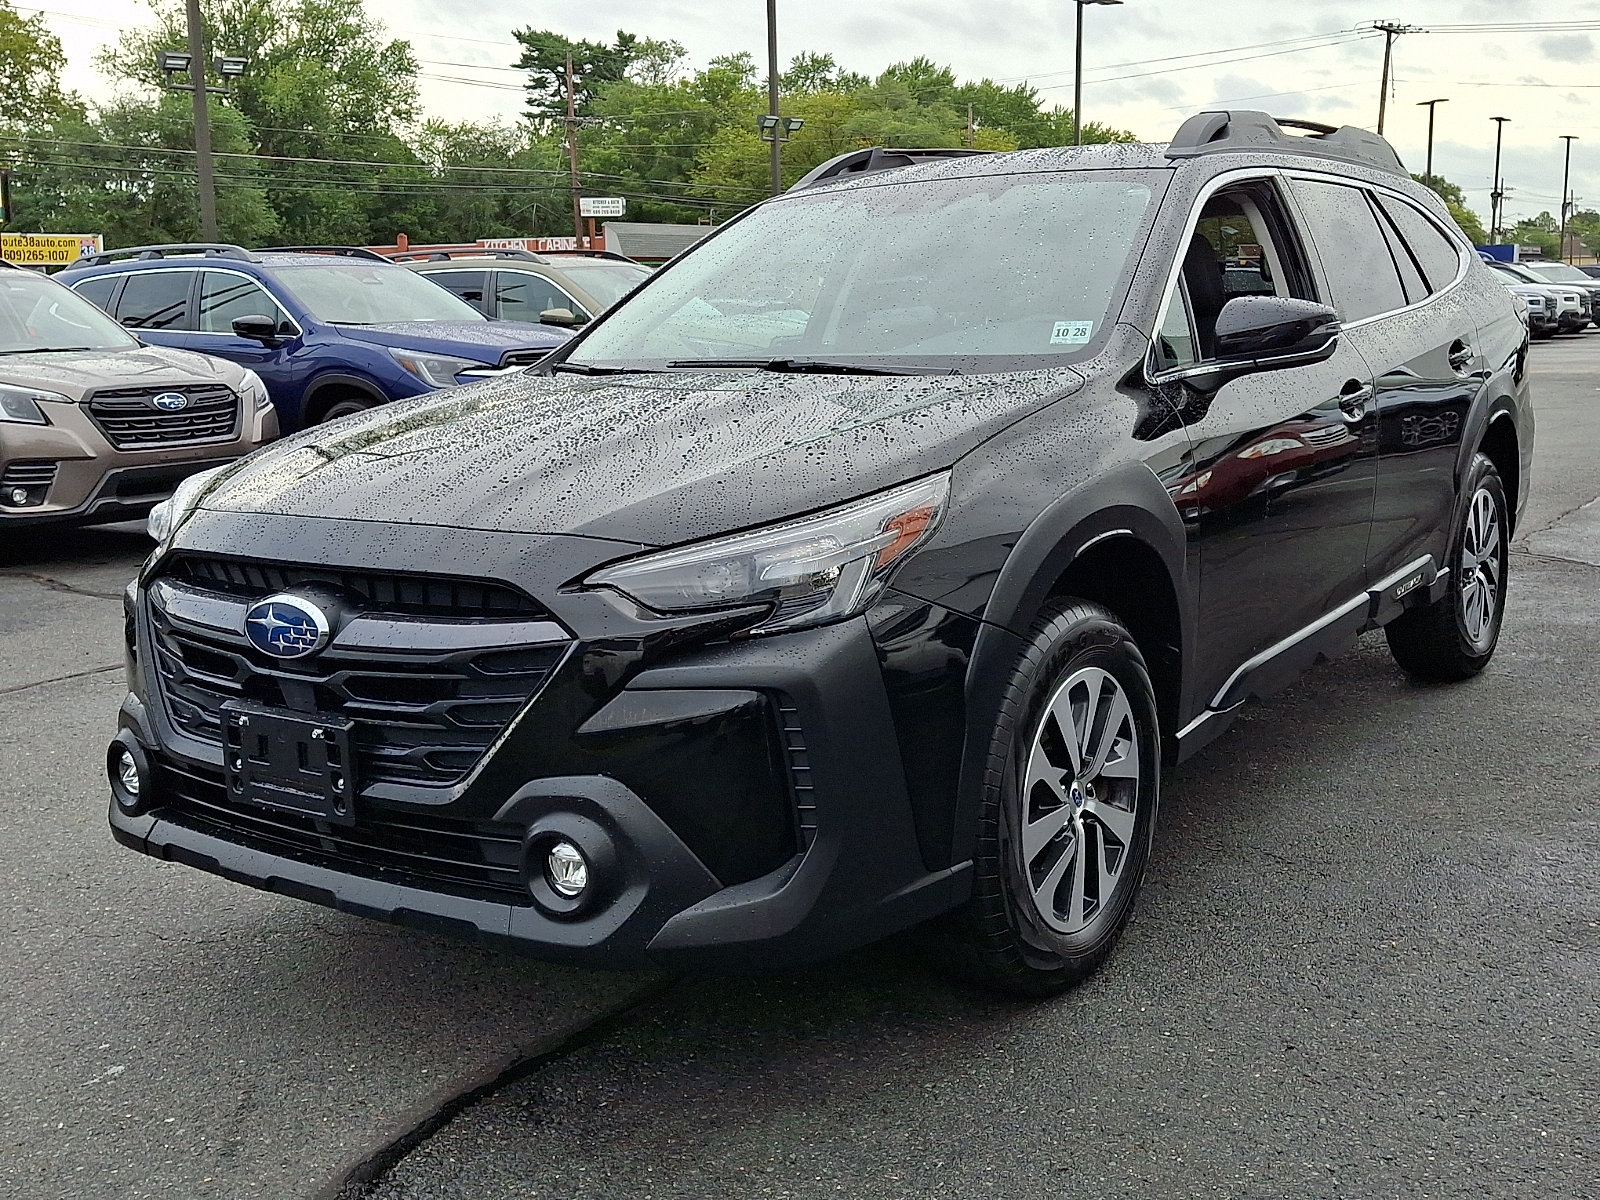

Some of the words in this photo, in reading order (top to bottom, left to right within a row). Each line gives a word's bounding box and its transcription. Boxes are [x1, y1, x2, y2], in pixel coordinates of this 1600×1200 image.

[484, 239, 527, 251] KITCHEN
[1054, 328, 1069, 337] 10
[1073, 327, 1087, 337] 28
